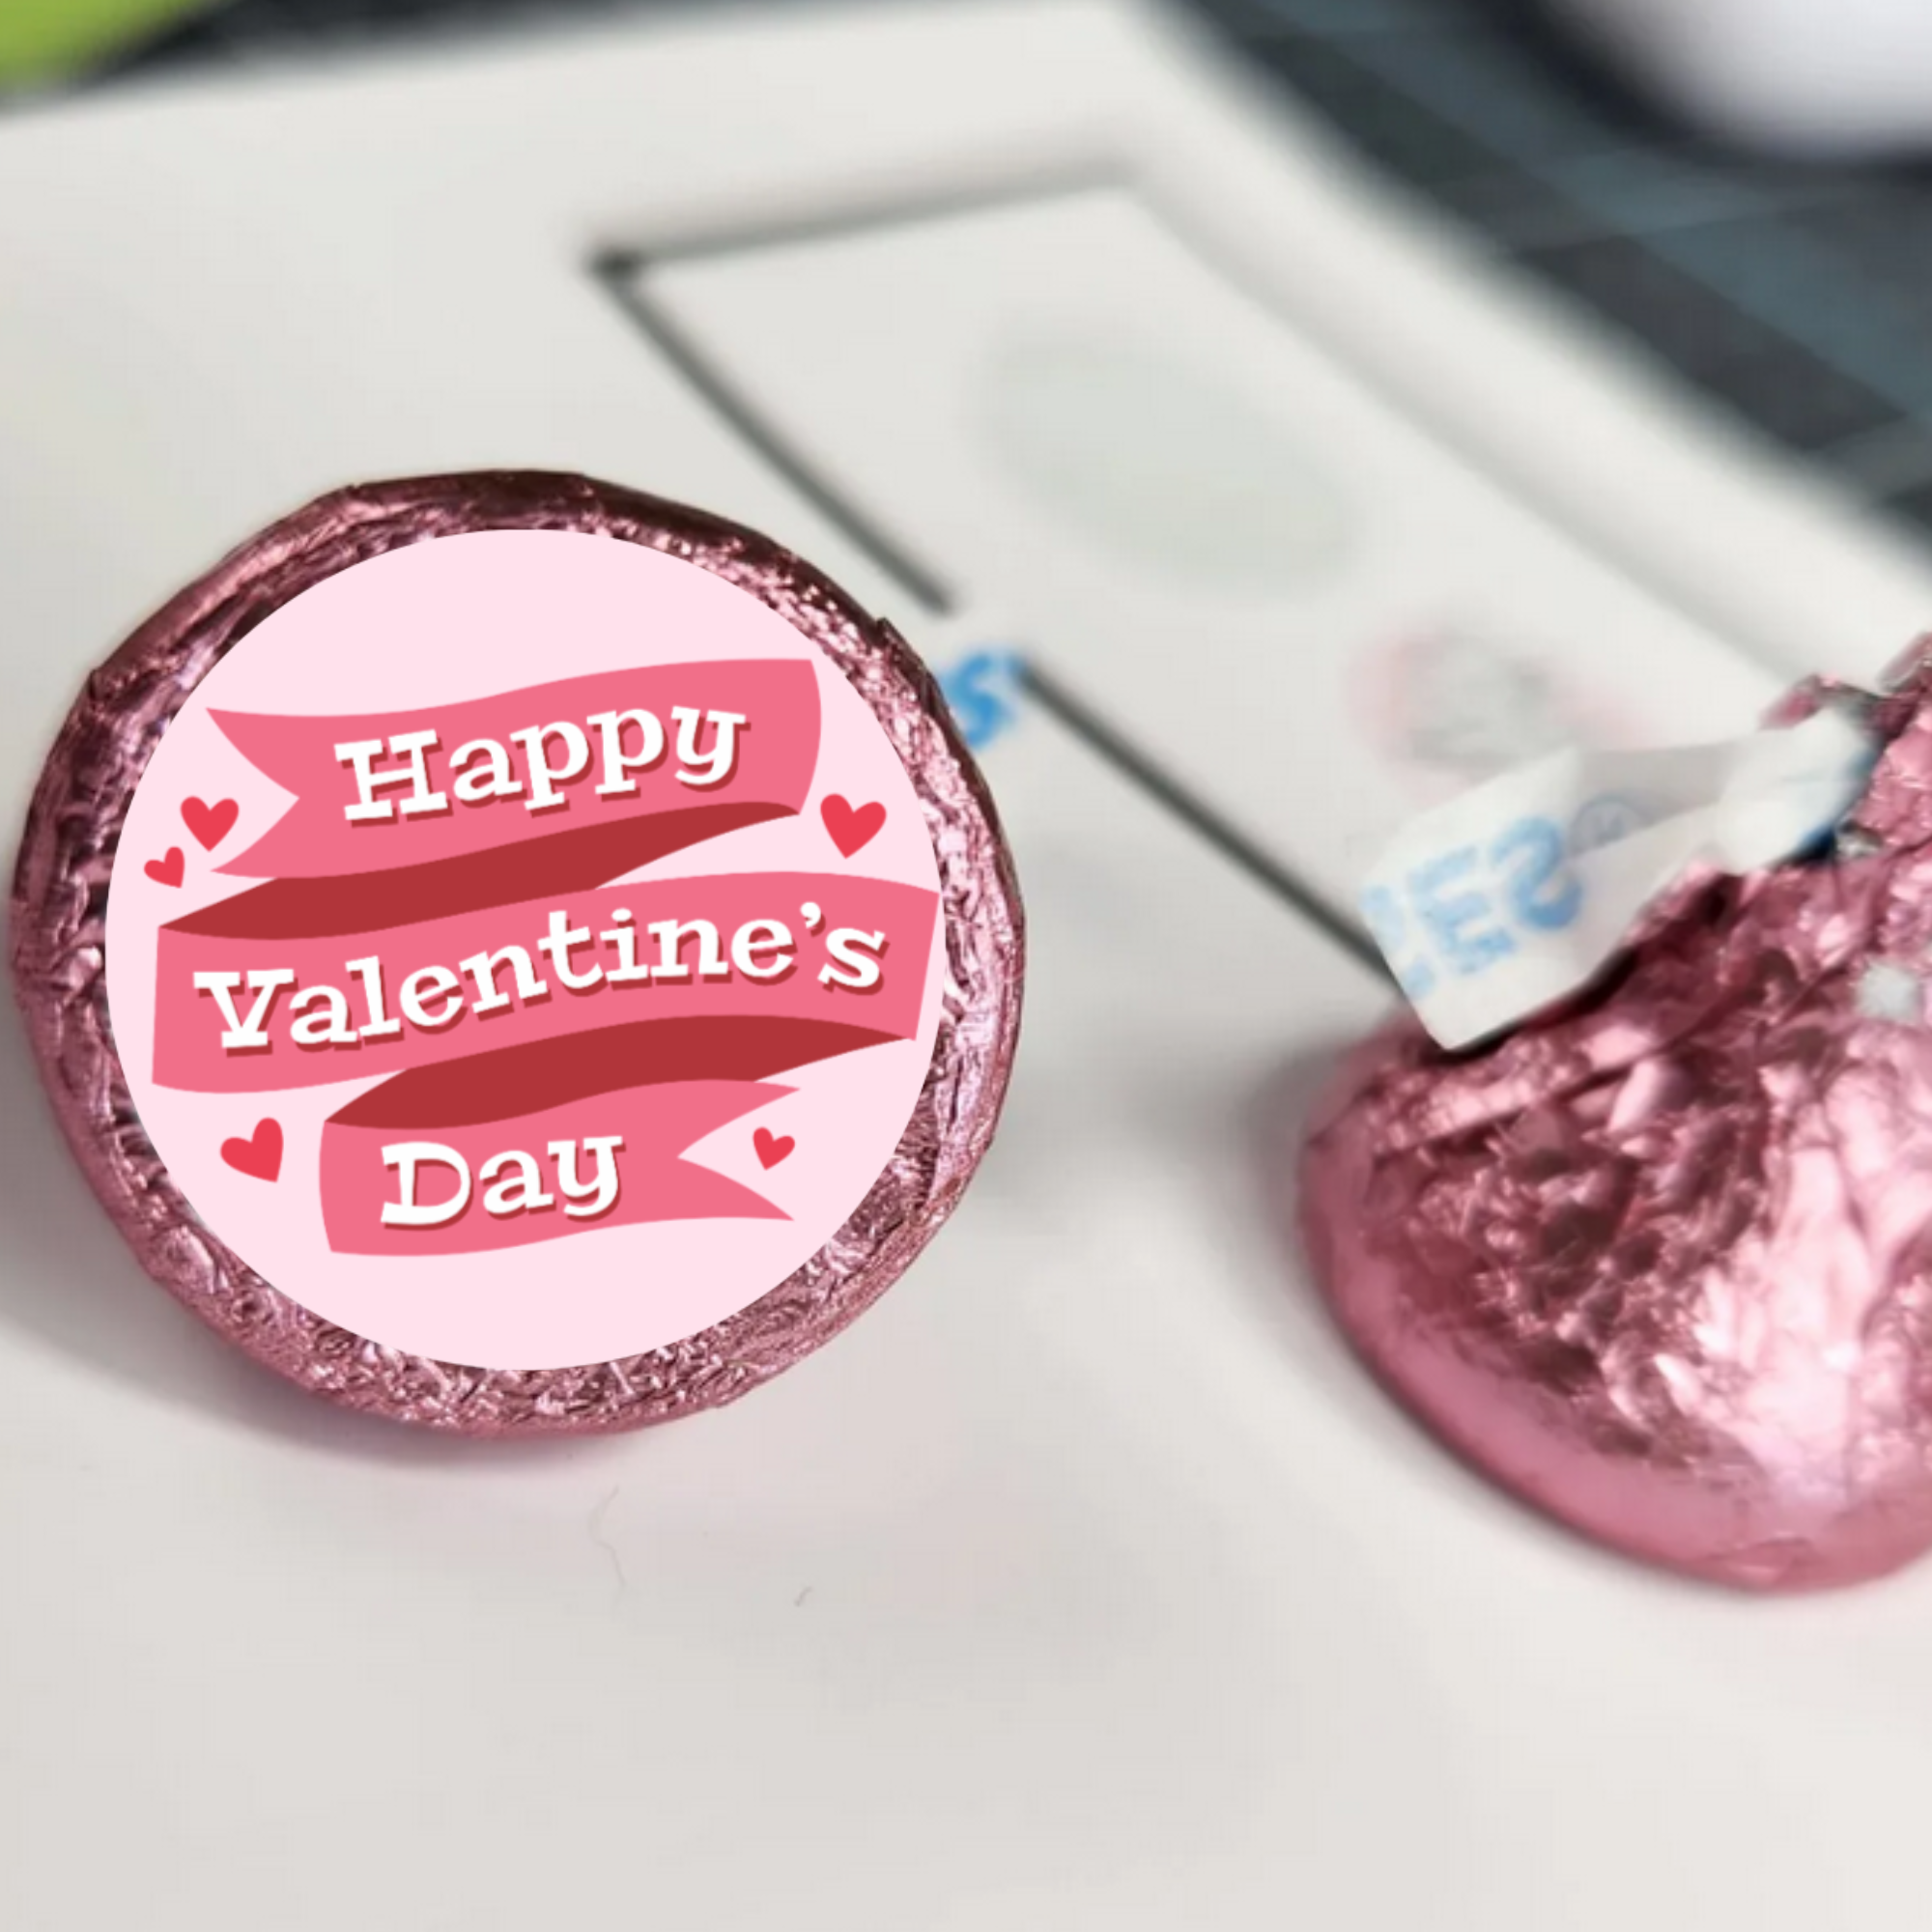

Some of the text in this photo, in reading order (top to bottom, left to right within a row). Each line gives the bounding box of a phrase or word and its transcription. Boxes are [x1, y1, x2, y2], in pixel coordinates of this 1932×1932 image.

[334, 706, 746, 821] Happy
[193, 901, 886, 1051] Valentine's
[381, 1136, 625, 1227] Day
